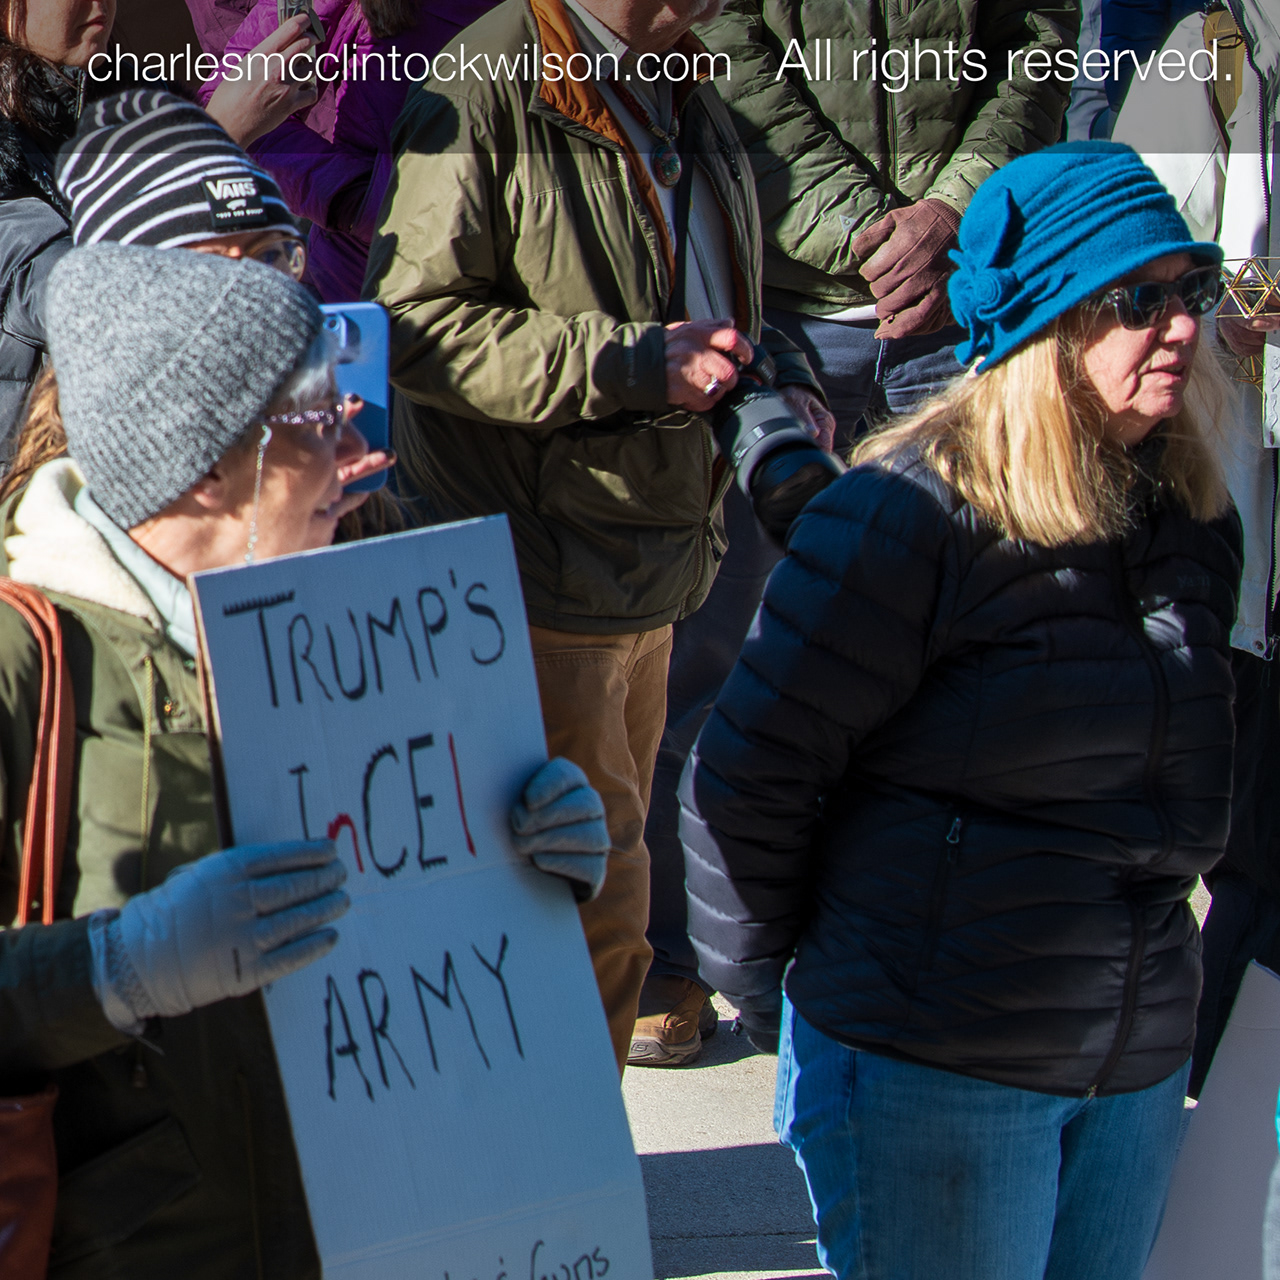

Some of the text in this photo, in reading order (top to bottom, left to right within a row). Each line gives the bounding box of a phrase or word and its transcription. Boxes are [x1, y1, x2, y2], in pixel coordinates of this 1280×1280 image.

[205, 177, 257, 201] VANS
[223, 568, 506, 708] TRUMP'S
[323, 933, 525, 1104] ARMY
